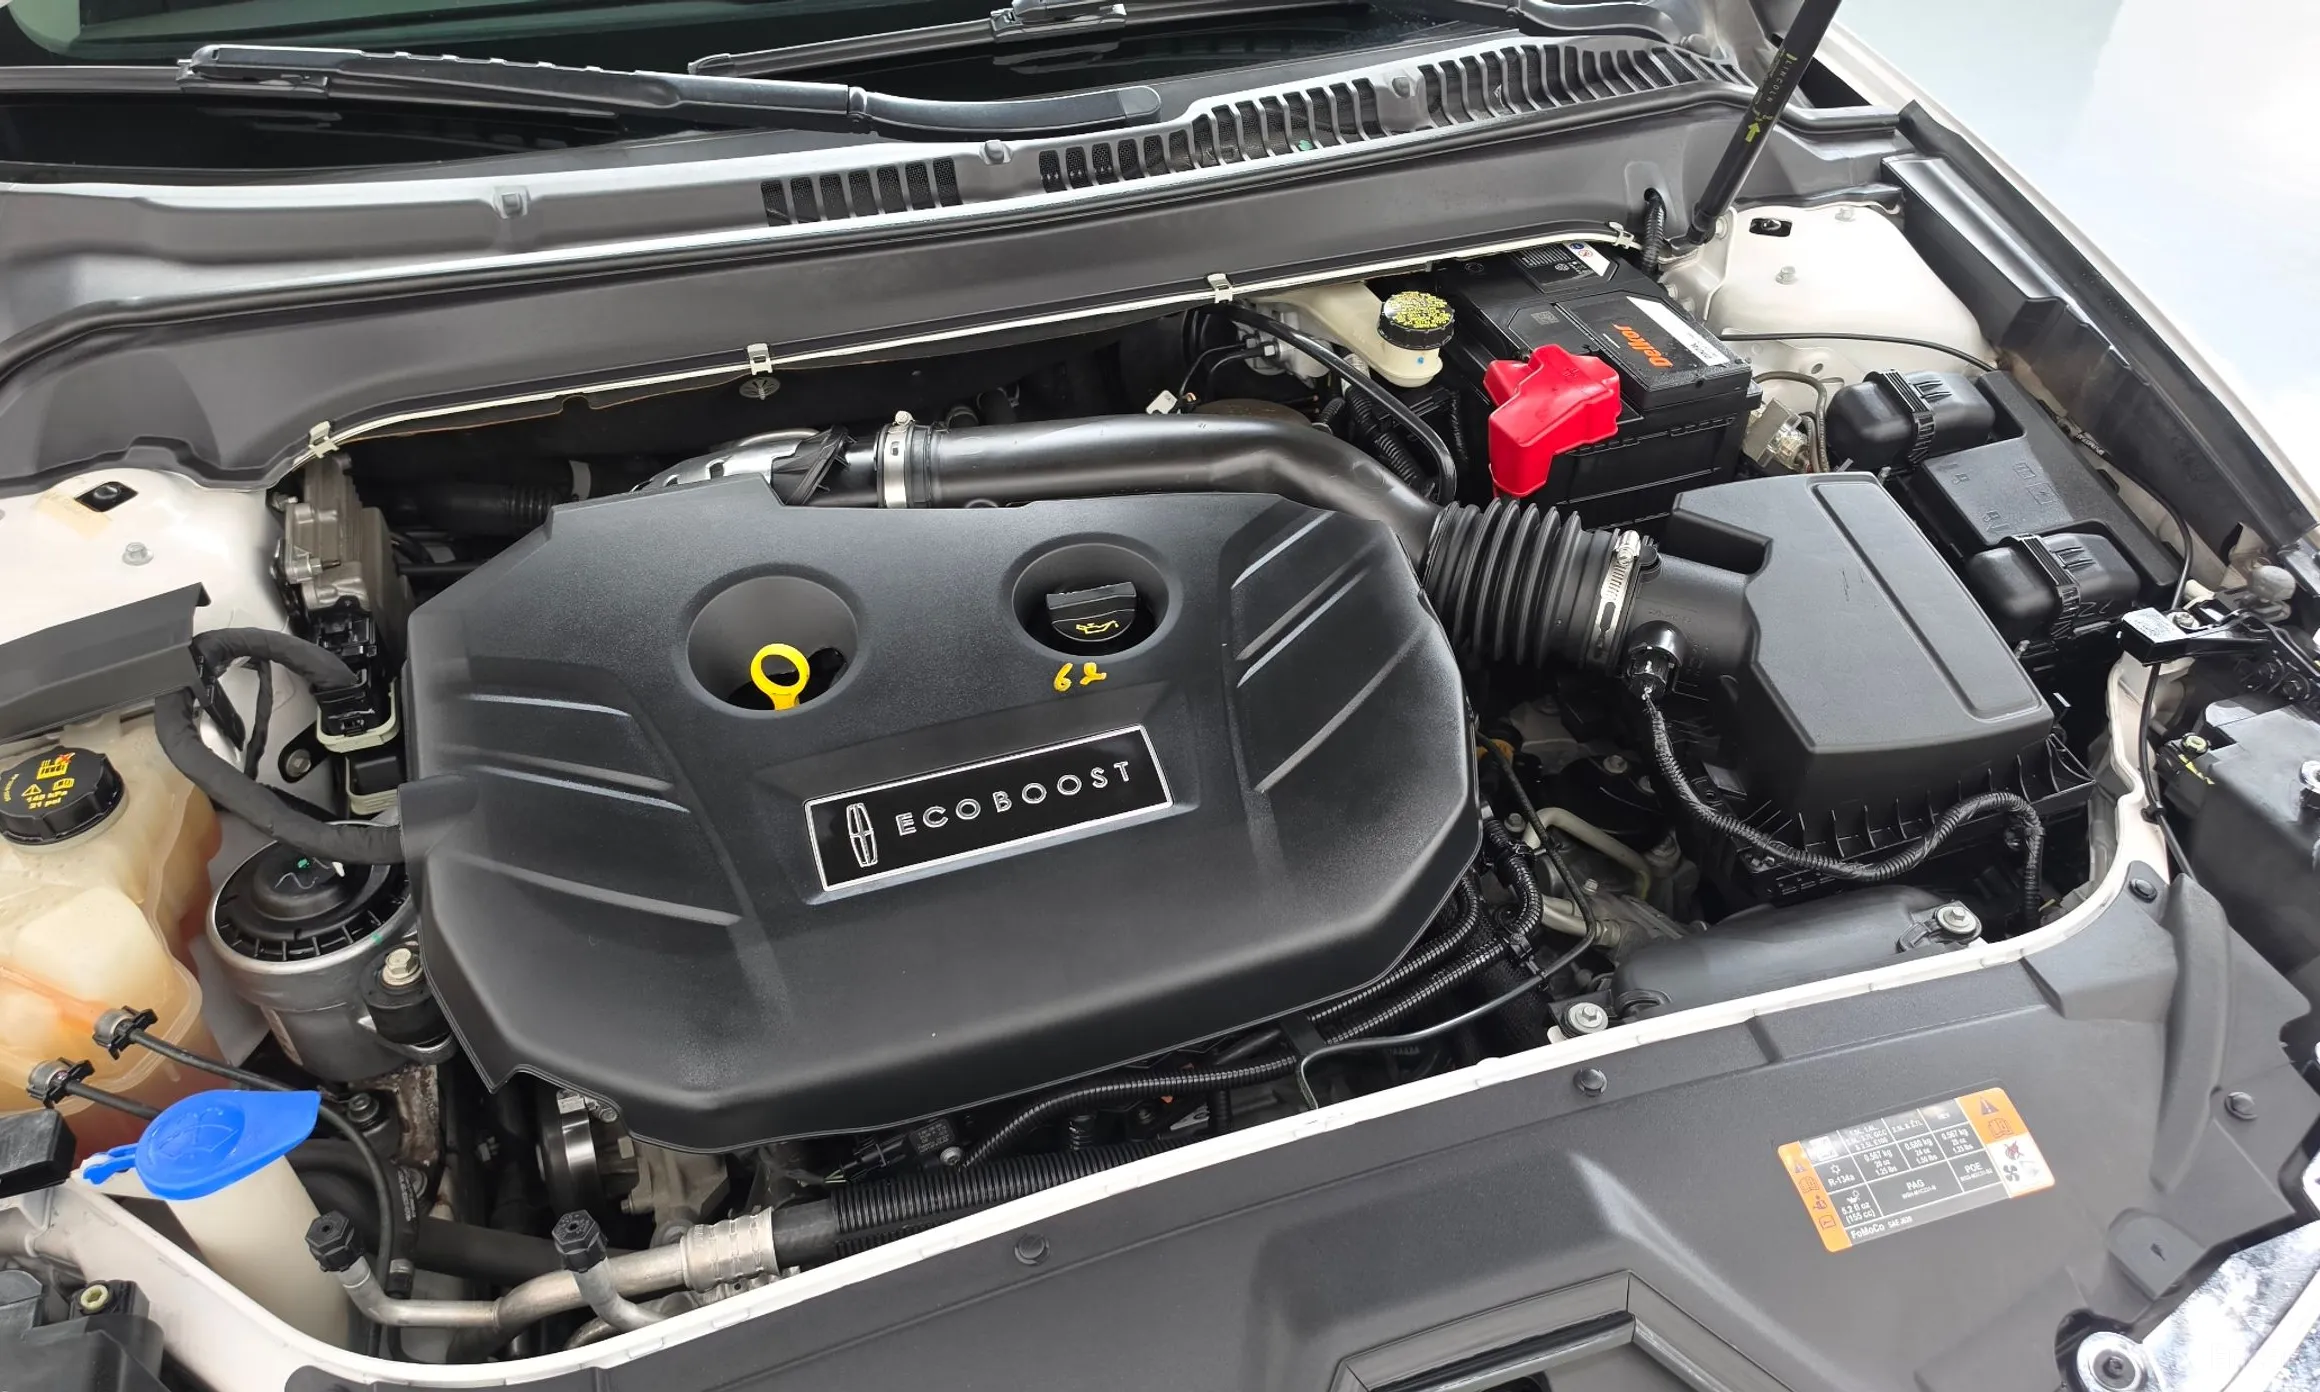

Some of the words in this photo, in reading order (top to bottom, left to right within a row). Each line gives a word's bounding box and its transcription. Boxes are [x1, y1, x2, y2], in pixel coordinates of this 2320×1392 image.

[1612, 322, 1674, 368] Delkor
[896, 761, 1130, 836] ECOBOOST
[1964, 1161, 1982, 1173] POE
[1827, 1174, 1855, 1186] R-134a
[1905, 1178, 1924, 1190] PAG
[1845, 1211, 1862, 1224] (155
[1862, 1207, 1875, 1218] cc)
[1850, 1223, 1885, 1239] FoMoCo
